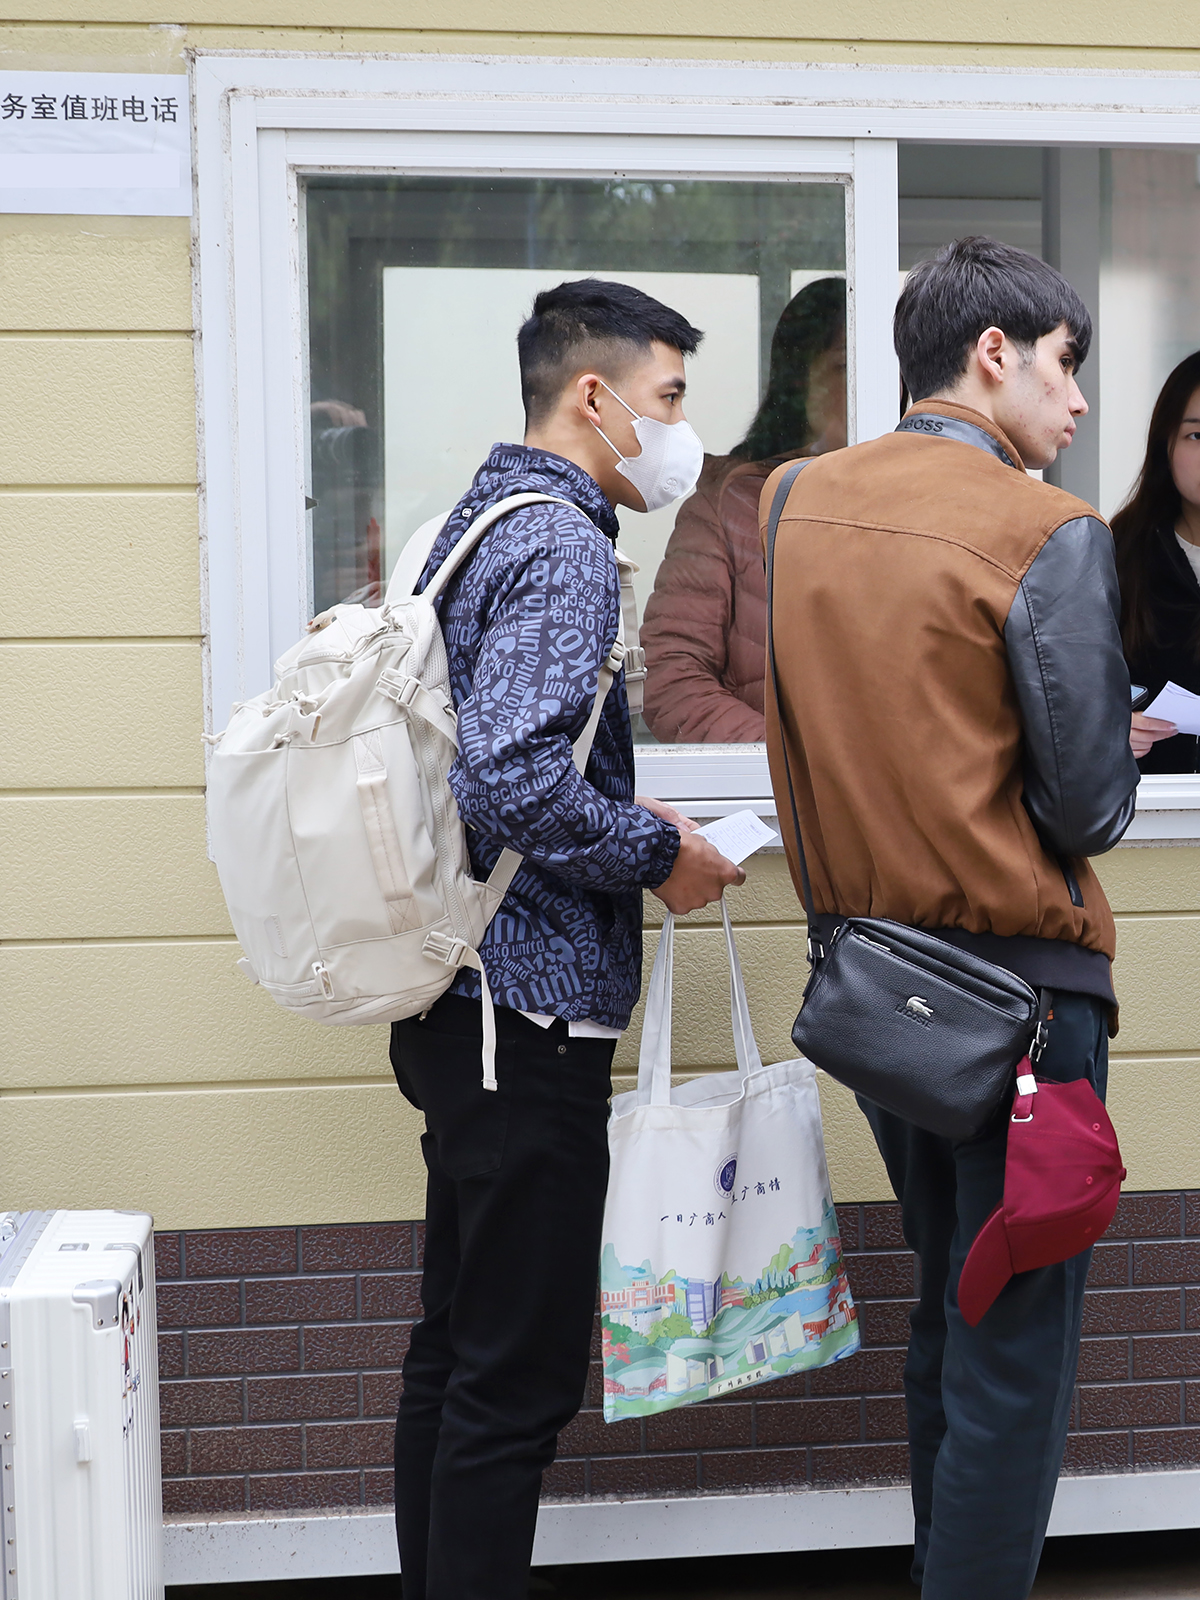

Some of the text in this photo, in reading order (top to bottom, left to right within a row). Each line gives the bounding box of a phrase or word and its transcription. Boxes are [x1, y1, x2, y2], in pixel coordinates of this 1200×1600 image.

[0, 93, 179, 123] 务室值班电话
[904, 419, 944, 433] BOSS
